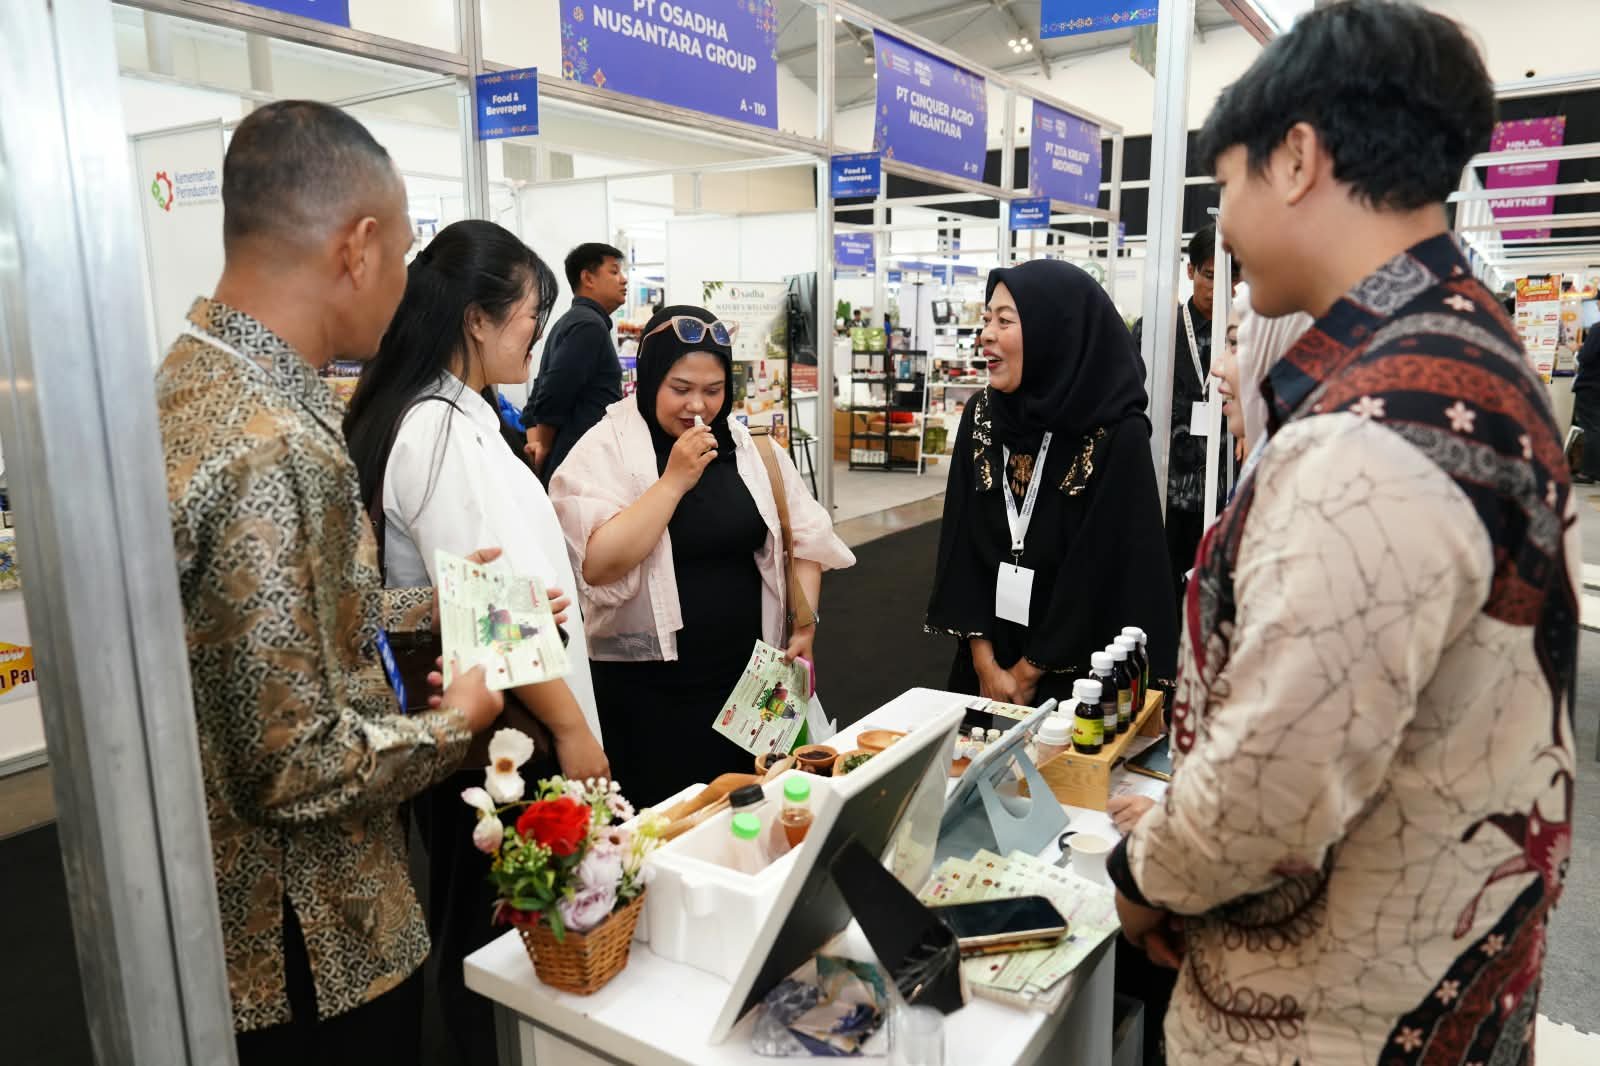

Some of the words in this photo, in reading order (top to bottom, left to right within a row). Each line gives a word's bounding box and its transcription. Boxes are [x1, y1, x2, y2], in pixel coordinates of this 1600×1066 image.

[633, 0, 656, 16] PT
[659, 2, 728, 42] OSADHA
[593, 5, 702, 59] NUSANTARA
[705, 43, 757, 73] GROUP
[486, 103, 527, 116] Beverages
[492, 92, 513, 105] Food
[513, 92, 519, 102] &
[740, 98, 748, 112] A
[896, 85, 909, 103] PT
[910, 91, 950, 119] CINQUER
[951, 106, 975, 127] AGRO
[909, 109, 962, 139] NUSANTARA
[1489, 197, 1547, 209] PARTNER
